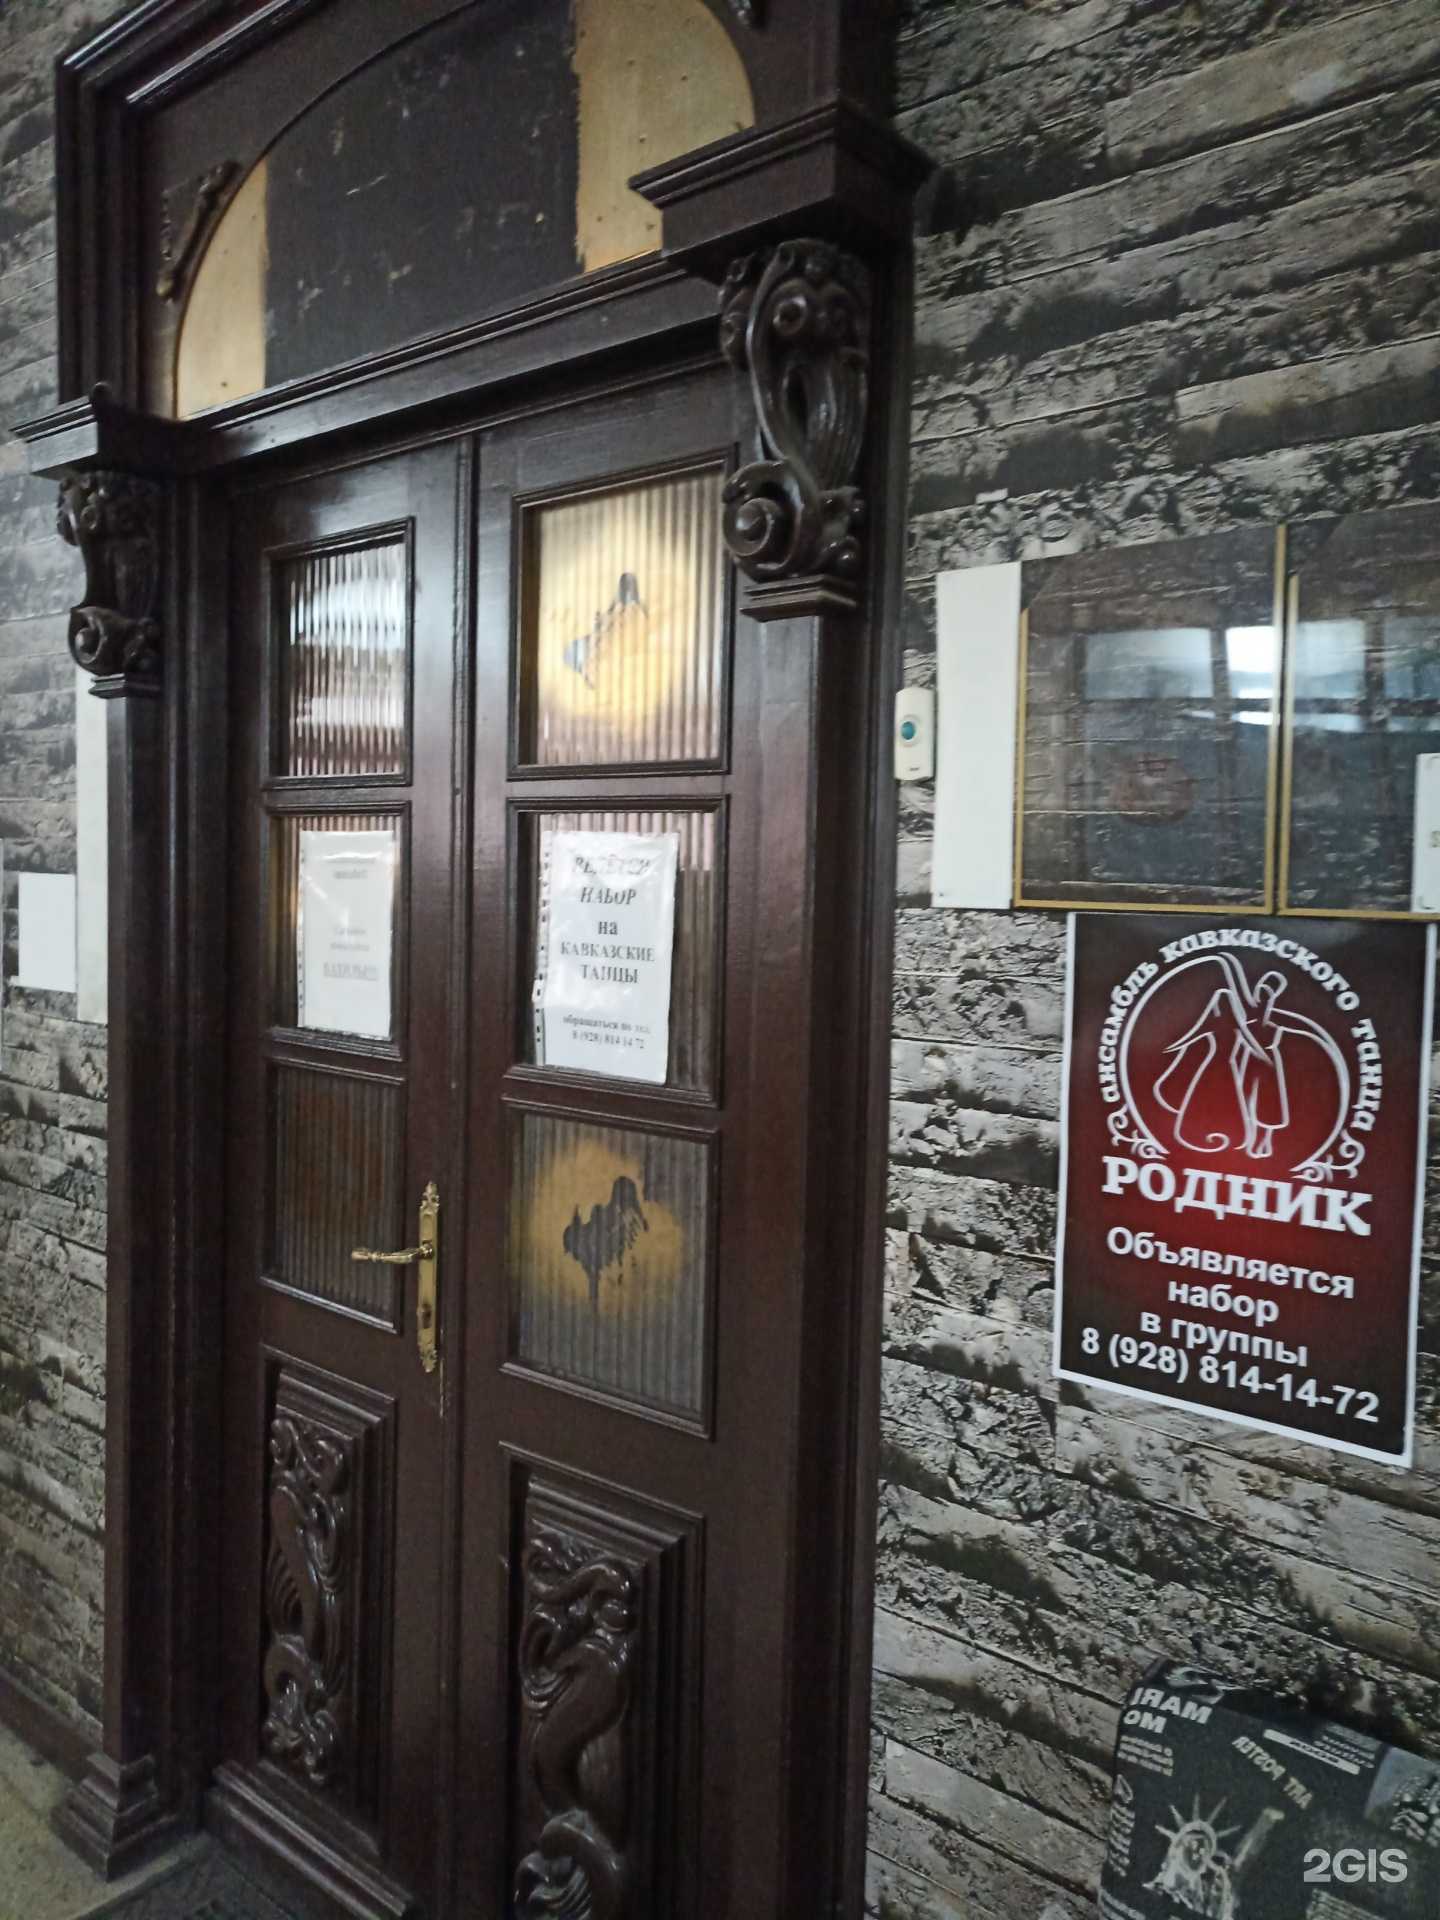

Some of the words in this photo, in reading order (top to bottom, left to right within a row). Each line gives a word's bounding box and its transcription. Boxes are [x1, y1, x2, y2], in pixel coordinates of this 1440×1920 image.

[560, 941, 656, 963] КАВКАЗСКИЕ
[598, 921, 618, 936] на
[581, 964, 639, 984] ТАНЦЫ
[1098, 961, 1159, 1103] ансамбль
[1158, 928, 1361, 1012] кавказского
[1350, 1018, 1382, 1131] танца
[1101, 1155, 1373, 1236] РОДНИК
[1107, 1226, 1355, 1299] Объявляется
[1168, 1280, 1280, 1328] набор
[1140, 1311, 1161, 1334] в
[1171, 1317, 1308, 1367] группы
[1081, 1327, 1100, 1354] 8
[1109, 1333, 1189, 1384] (928)
[1199, 1355, 1380, 1423] 814-14-72
